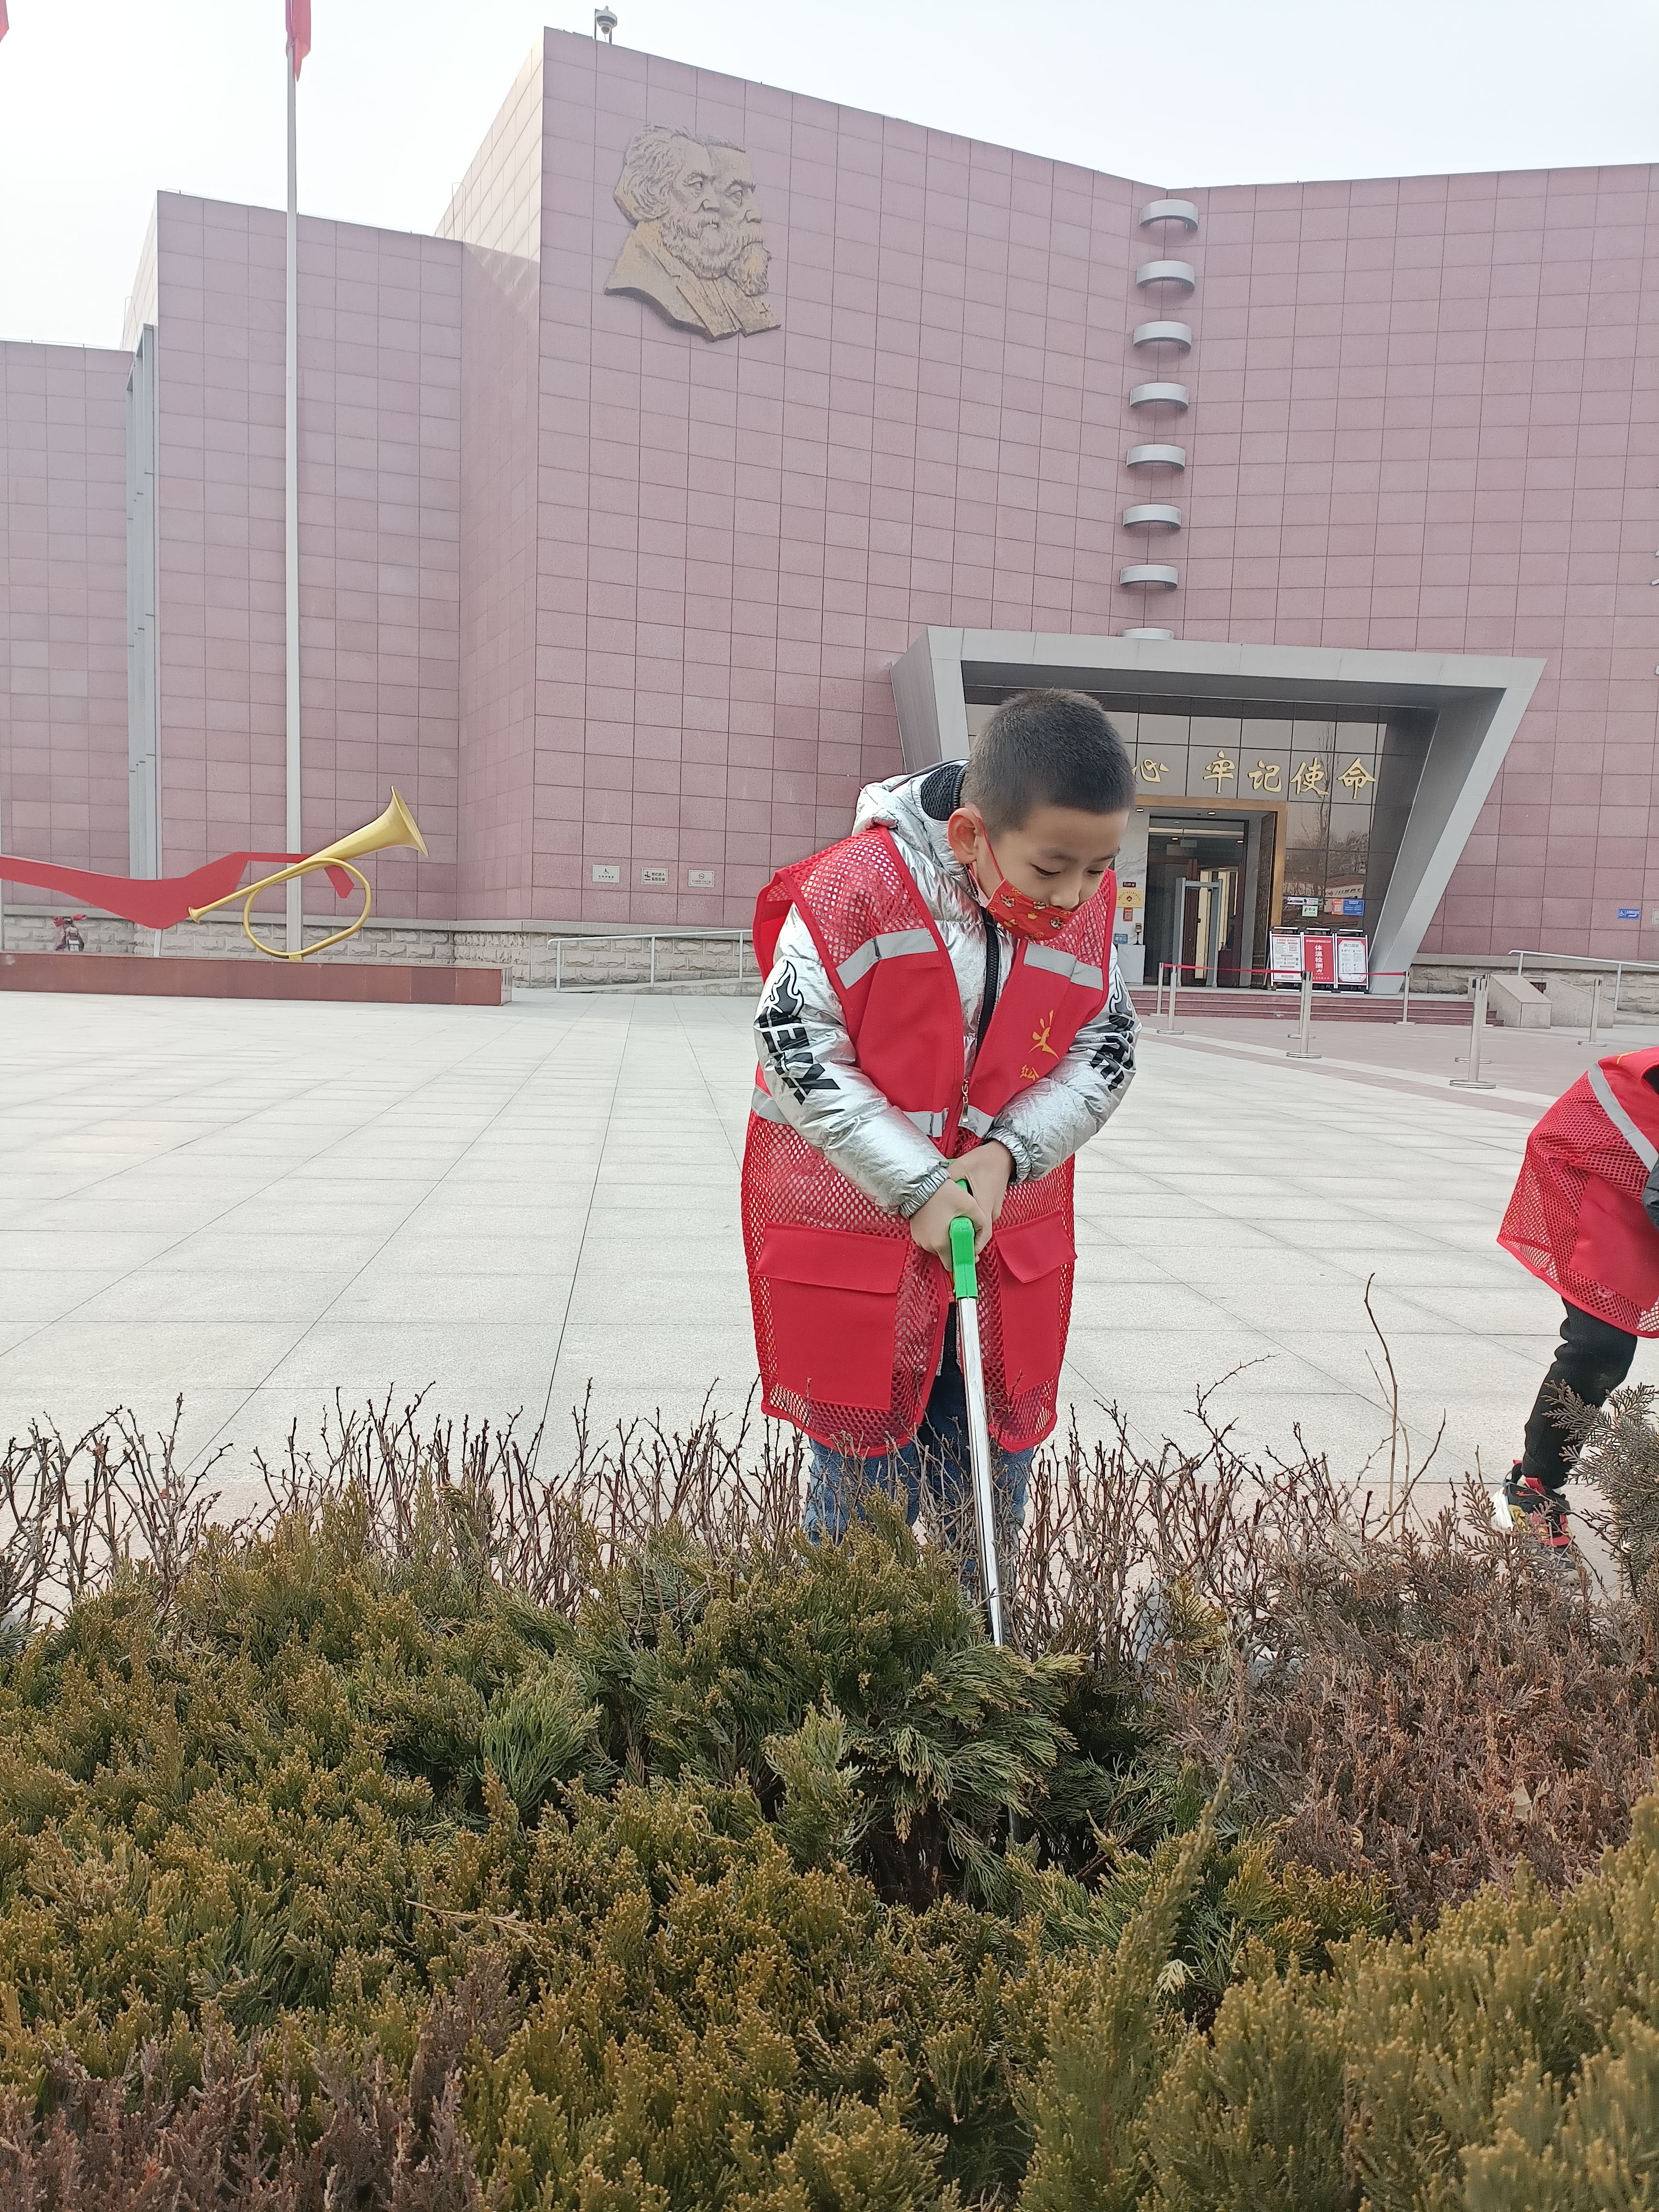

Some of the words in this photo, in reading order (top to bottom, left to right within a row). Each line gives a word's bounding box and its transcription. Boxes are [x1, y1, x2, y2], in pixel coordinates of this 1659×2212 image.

[1132, 759, 1170, 783] 心
[1203, 750, 1377, 799] 牢记使命
